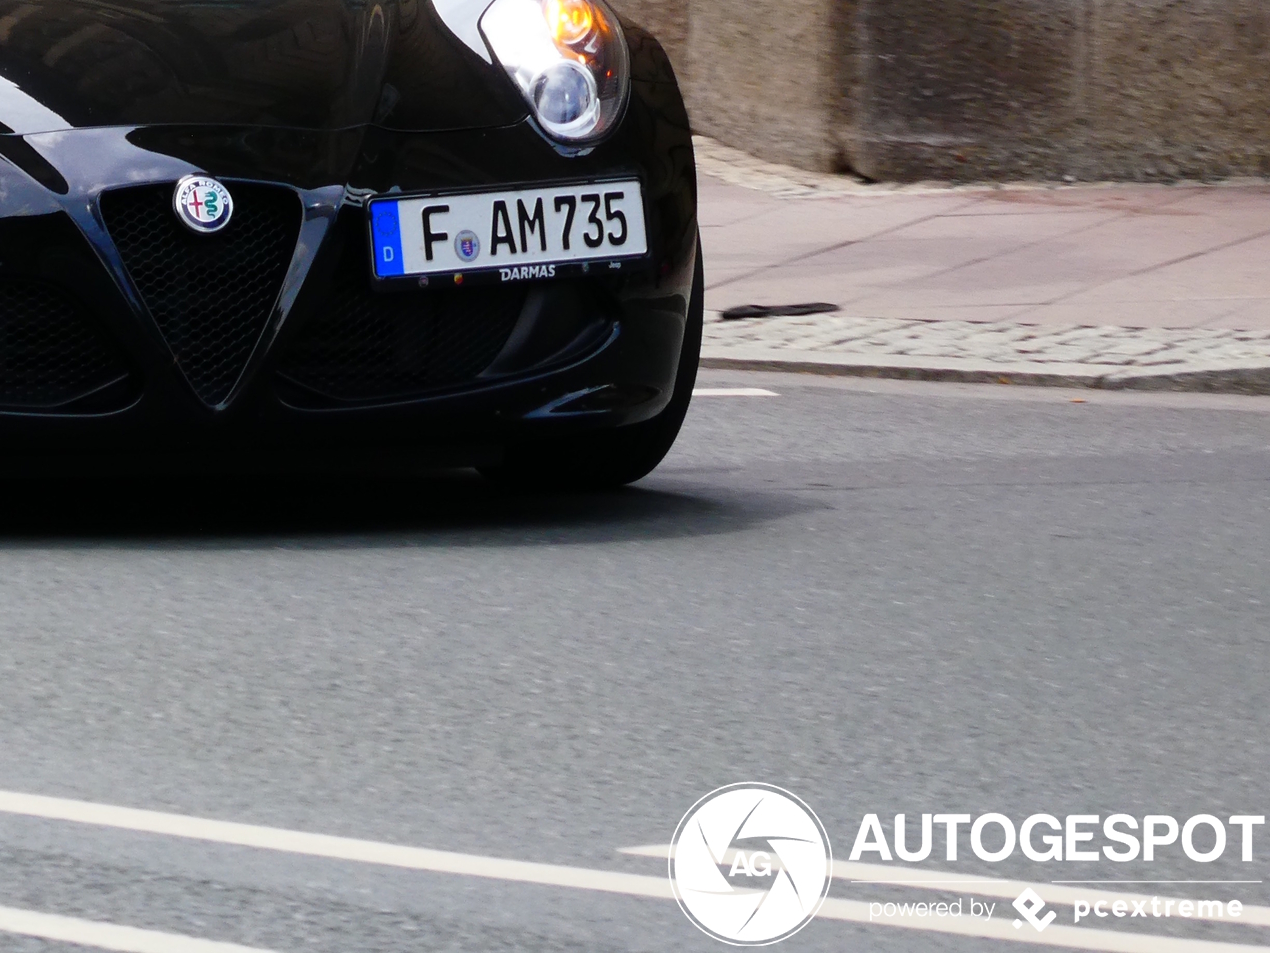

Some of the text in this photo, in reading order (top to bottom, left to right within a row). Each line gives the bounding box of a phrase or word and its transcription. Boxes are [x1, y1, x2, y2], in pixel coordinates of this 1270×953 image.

[181, 180, 229, 205] ALFA ROMEO
[383, 246, 394, 262] D
[421, 204, 450, 261] F
[499, 264, 556, 281] DARMAS
